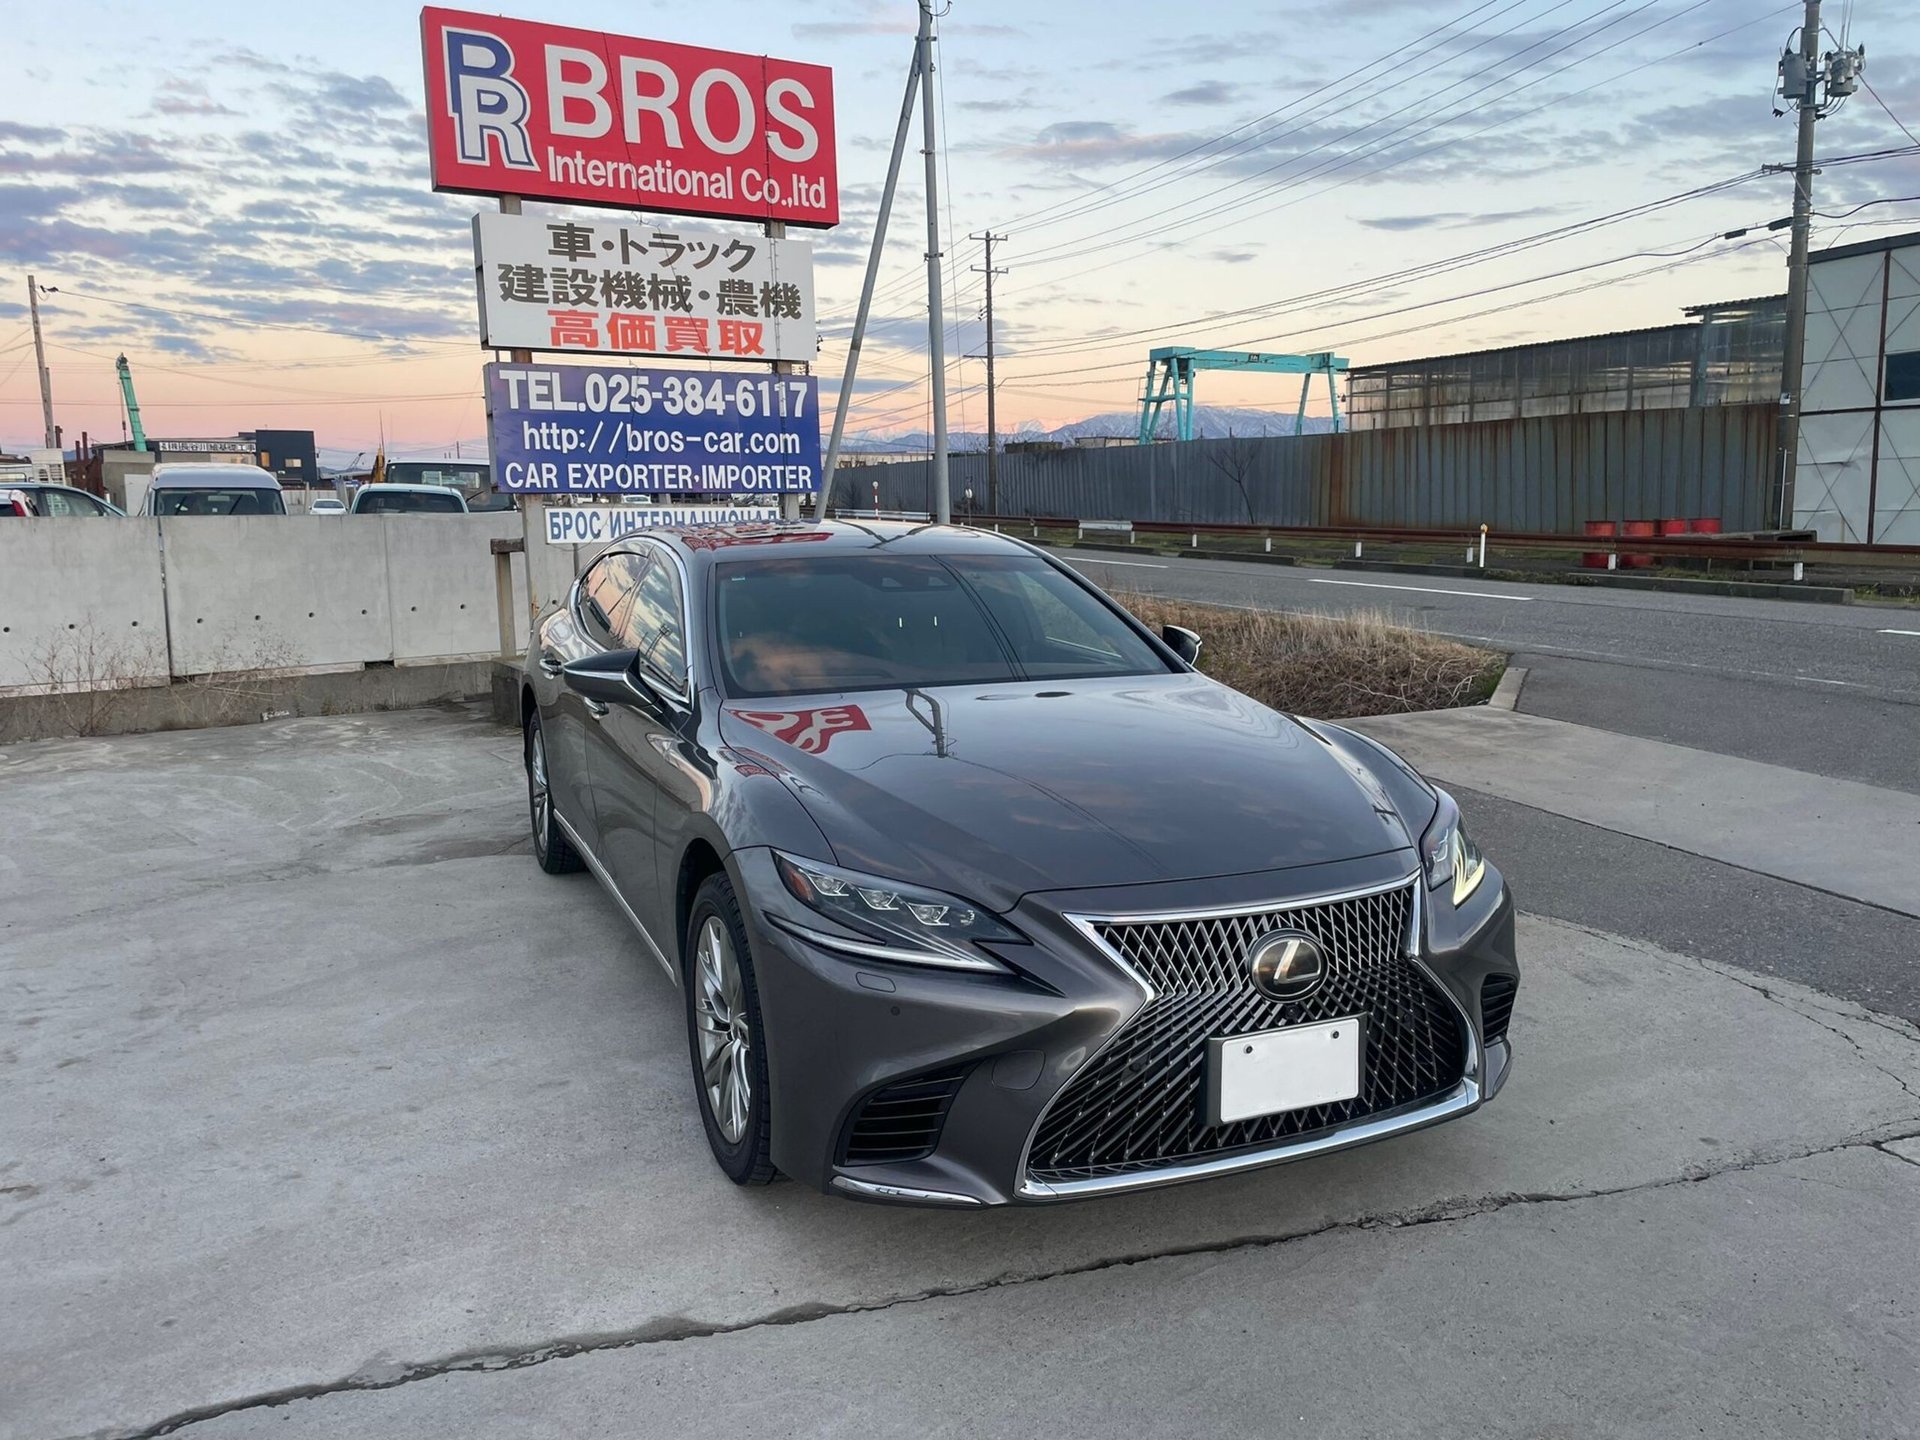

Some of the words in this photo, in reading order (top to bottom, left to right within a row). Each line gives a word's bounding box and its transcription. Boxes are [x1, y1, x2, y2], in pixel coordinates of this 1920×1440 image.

[544, 44, 819, 163] BROS
[548, 146, 733, 200] International
[497, 263, 802, 320] 建設機械・農機
[547, 309, 765, 356] 高価買取
[505, 462, 558, 488] CAR
[549, 511, 601, 540] БРОС
